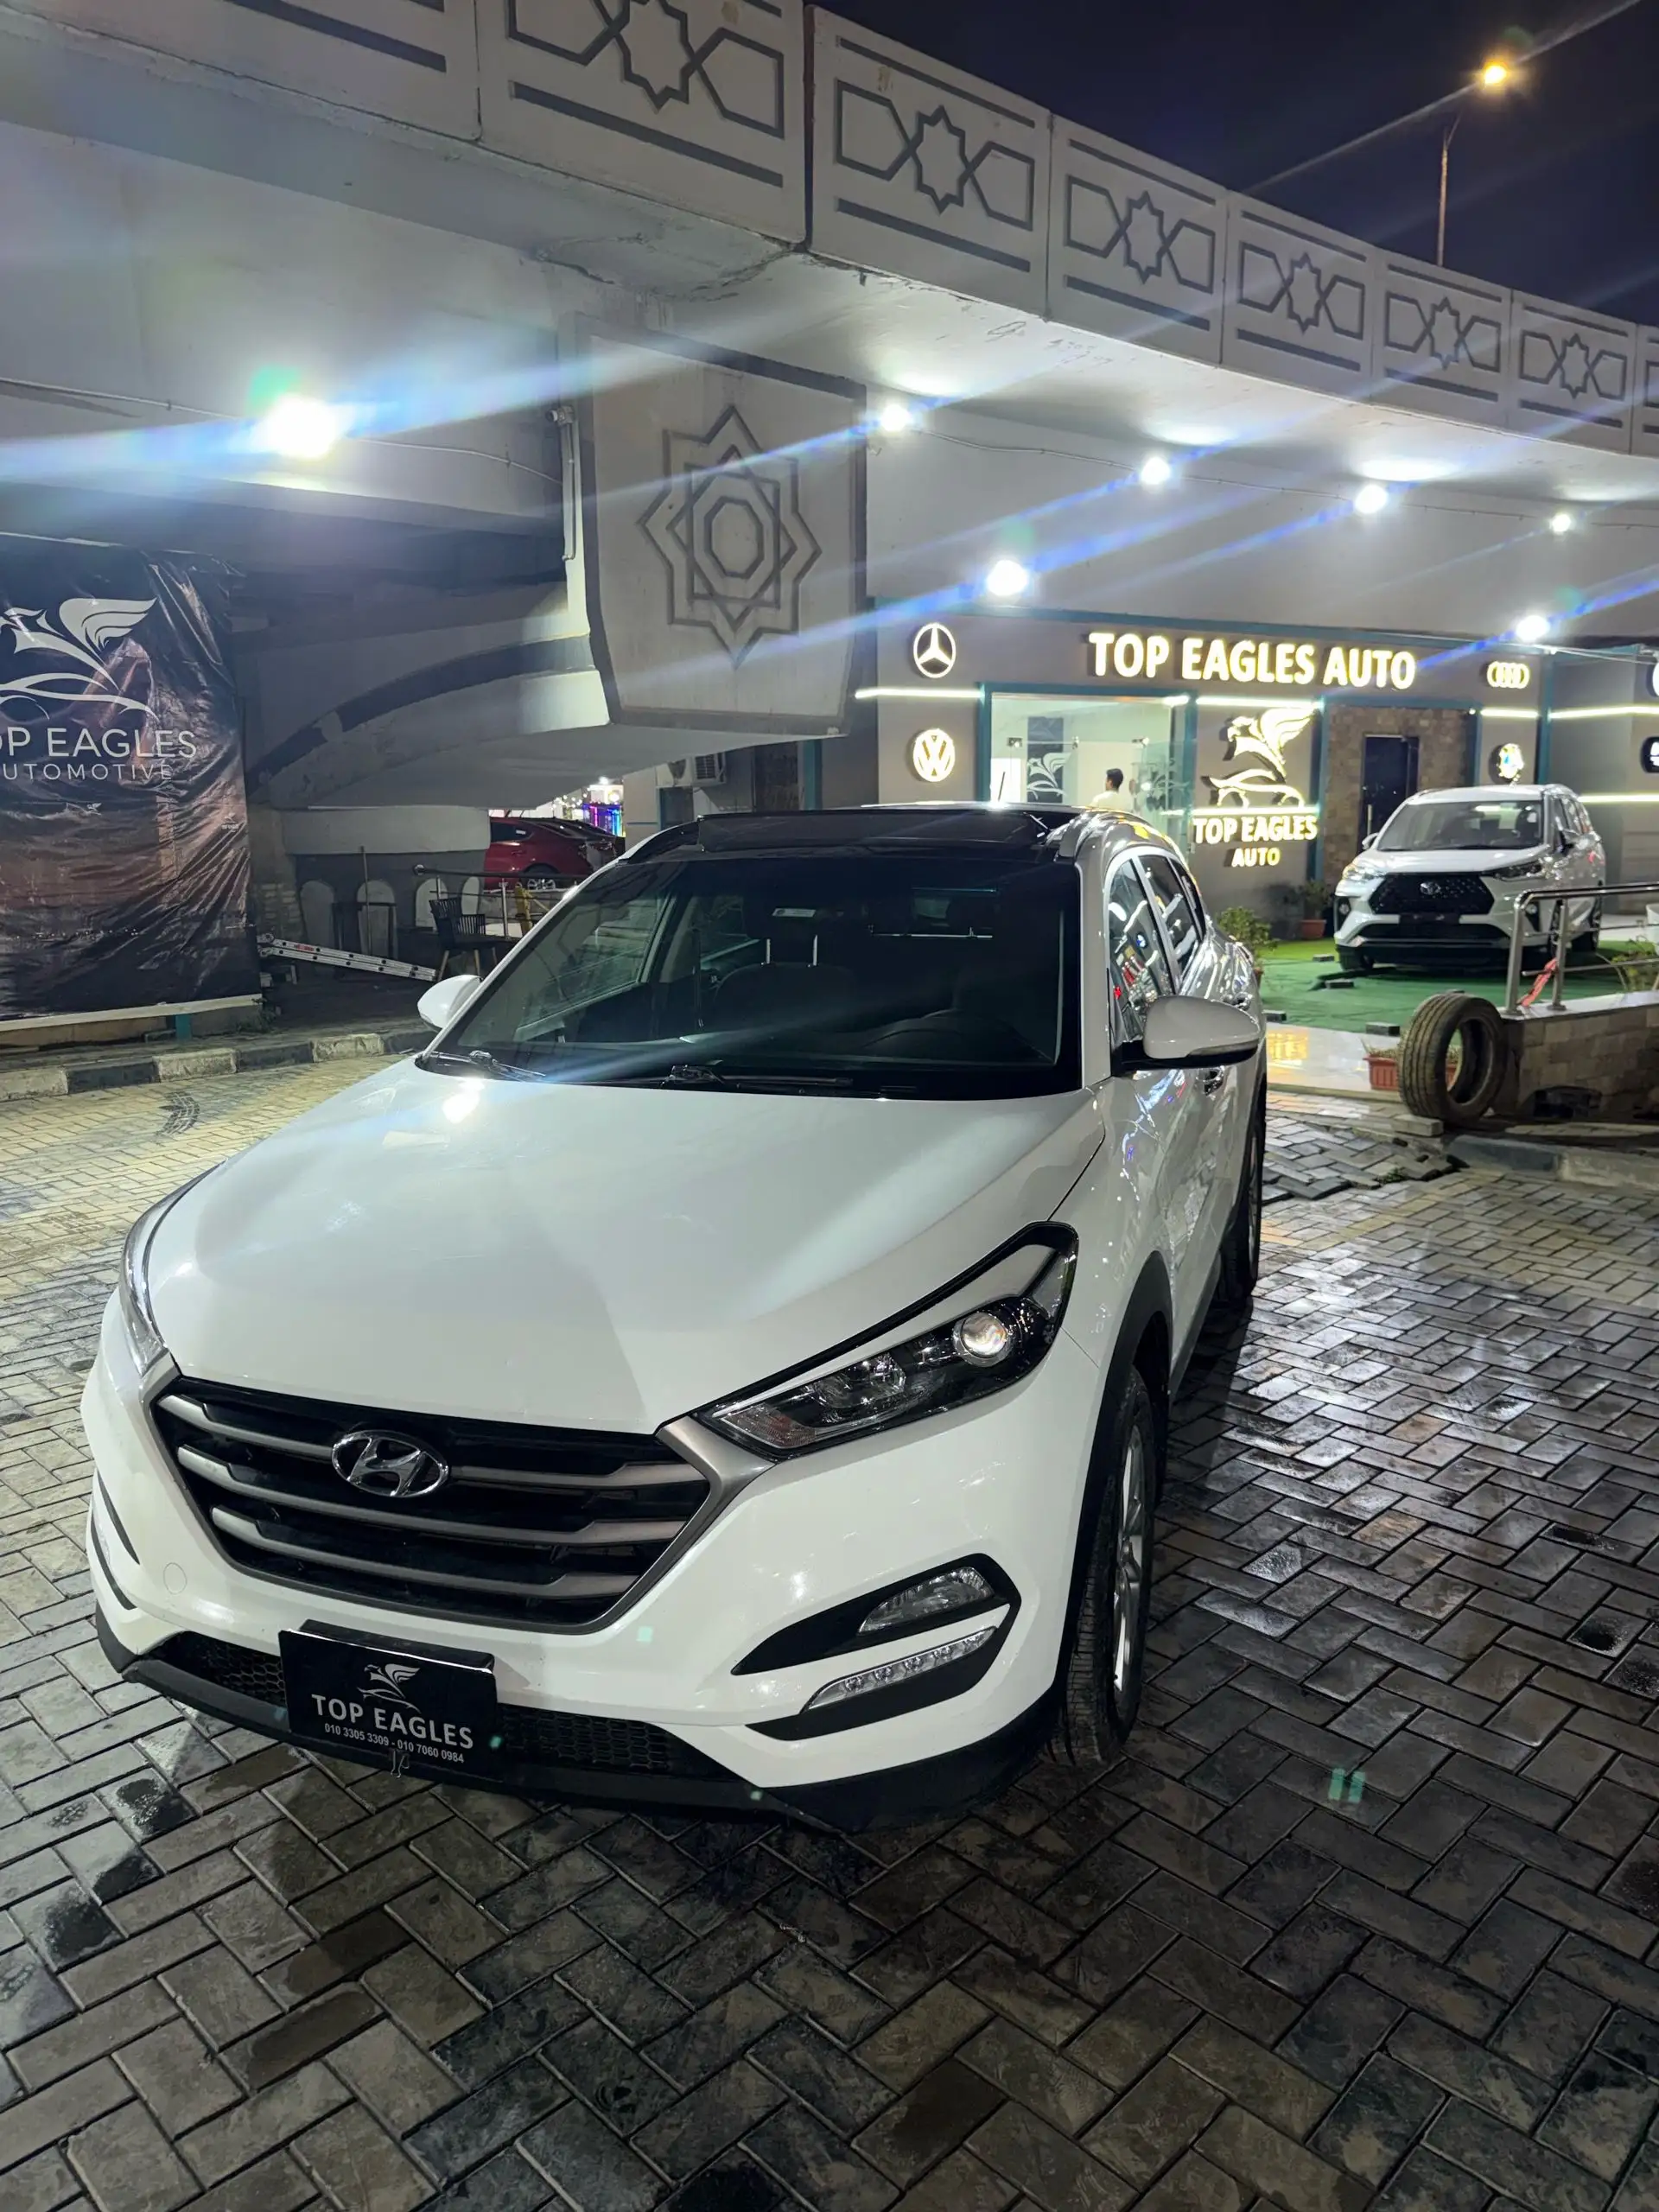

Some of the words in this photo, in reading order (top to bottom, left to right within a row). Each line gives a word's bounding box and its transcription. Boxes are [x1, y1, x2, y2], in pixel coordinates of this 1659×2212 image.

[1088, 632, 1170, 678] TOP
[1181, 638, 1315, 684] EAGLES
[1322, 646, 1415, 690] AUTO
[0, 727, 31, 756] P
[47, 728, 197, 759] EAGLES
[1192, 817, 1238, 844] TOP
[1240, 815, 1319, 842] EAGLES
[1231, 847, 1281, 868] AUTO
[311, 1694, 364, 1724] TOP
[374, 1707, 474, 1750] EAGLES
[324, 1723, 341, 1735] 010
[342, 1727, 365, 1741] 3305
[397, 1739, 414, 1752] 010
[416, 1745, 439, 1758] 7060
[441, 1750, 465, 1764] 0984
